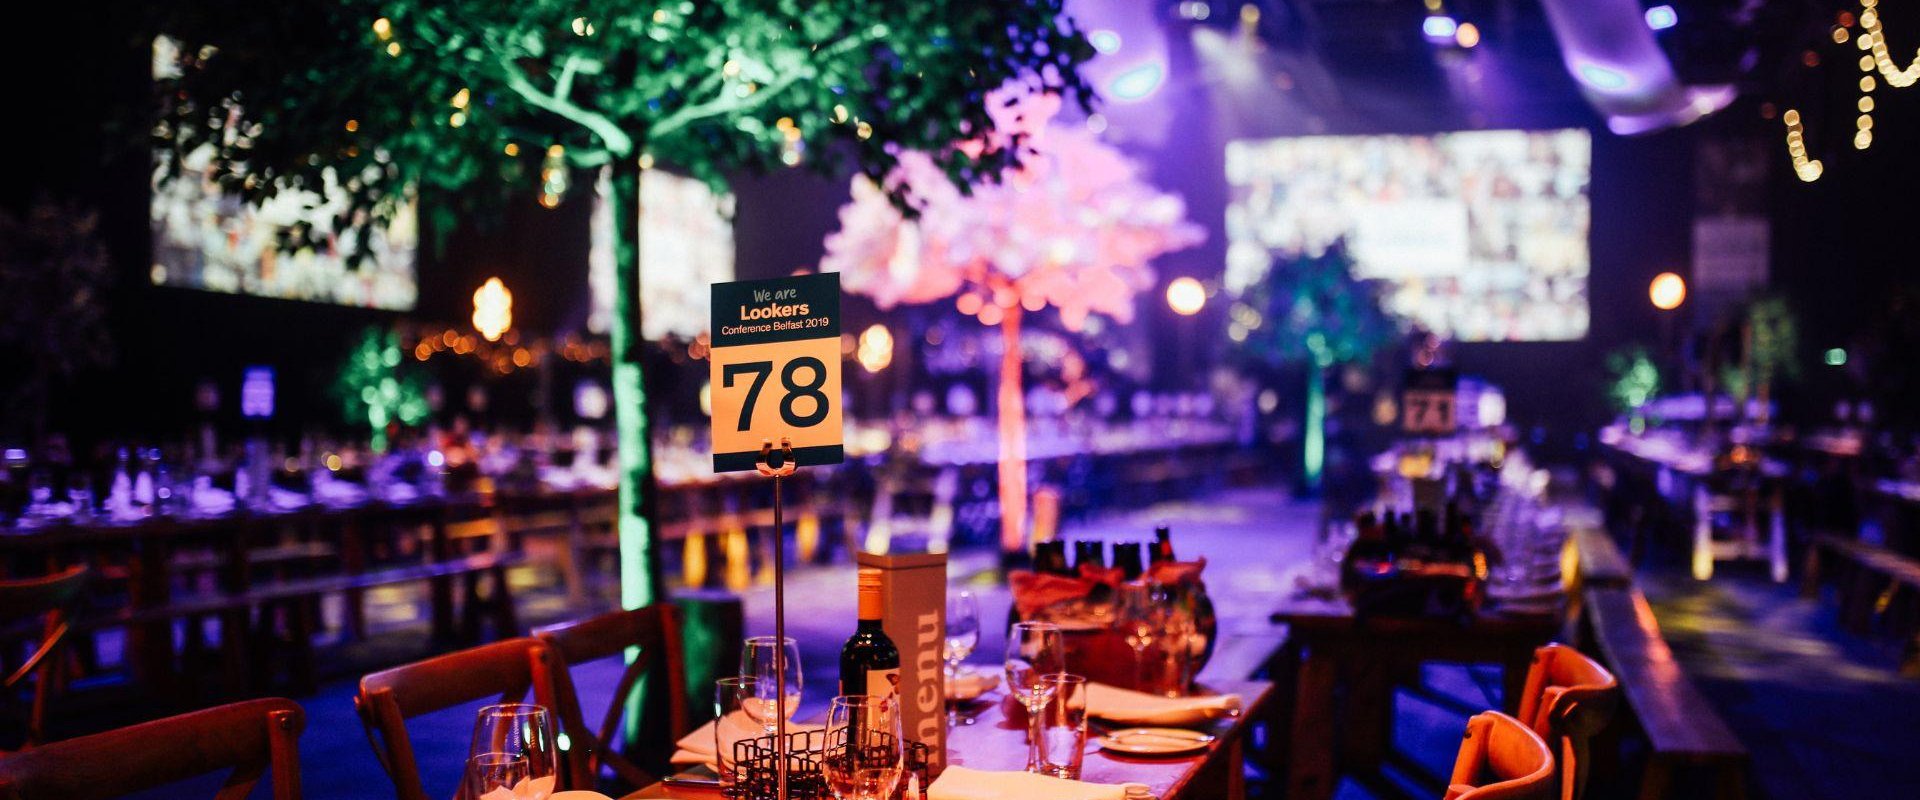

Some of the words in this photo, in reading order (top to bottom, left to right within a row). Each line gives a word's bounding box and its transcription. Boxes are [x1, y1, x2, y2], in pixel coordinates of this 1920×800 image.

[753, 289, 771, 303] We
[775, 287, 797, 300] are
[740, 302, 810, 321] Lookers
[721, 322, 771, 336] Conference
[773, 320, 804, 332] Belfast
[805, 317, 830, 328] 2019
[722, 356, 830, 432] 78
[917, 609, 939, 766] menu
